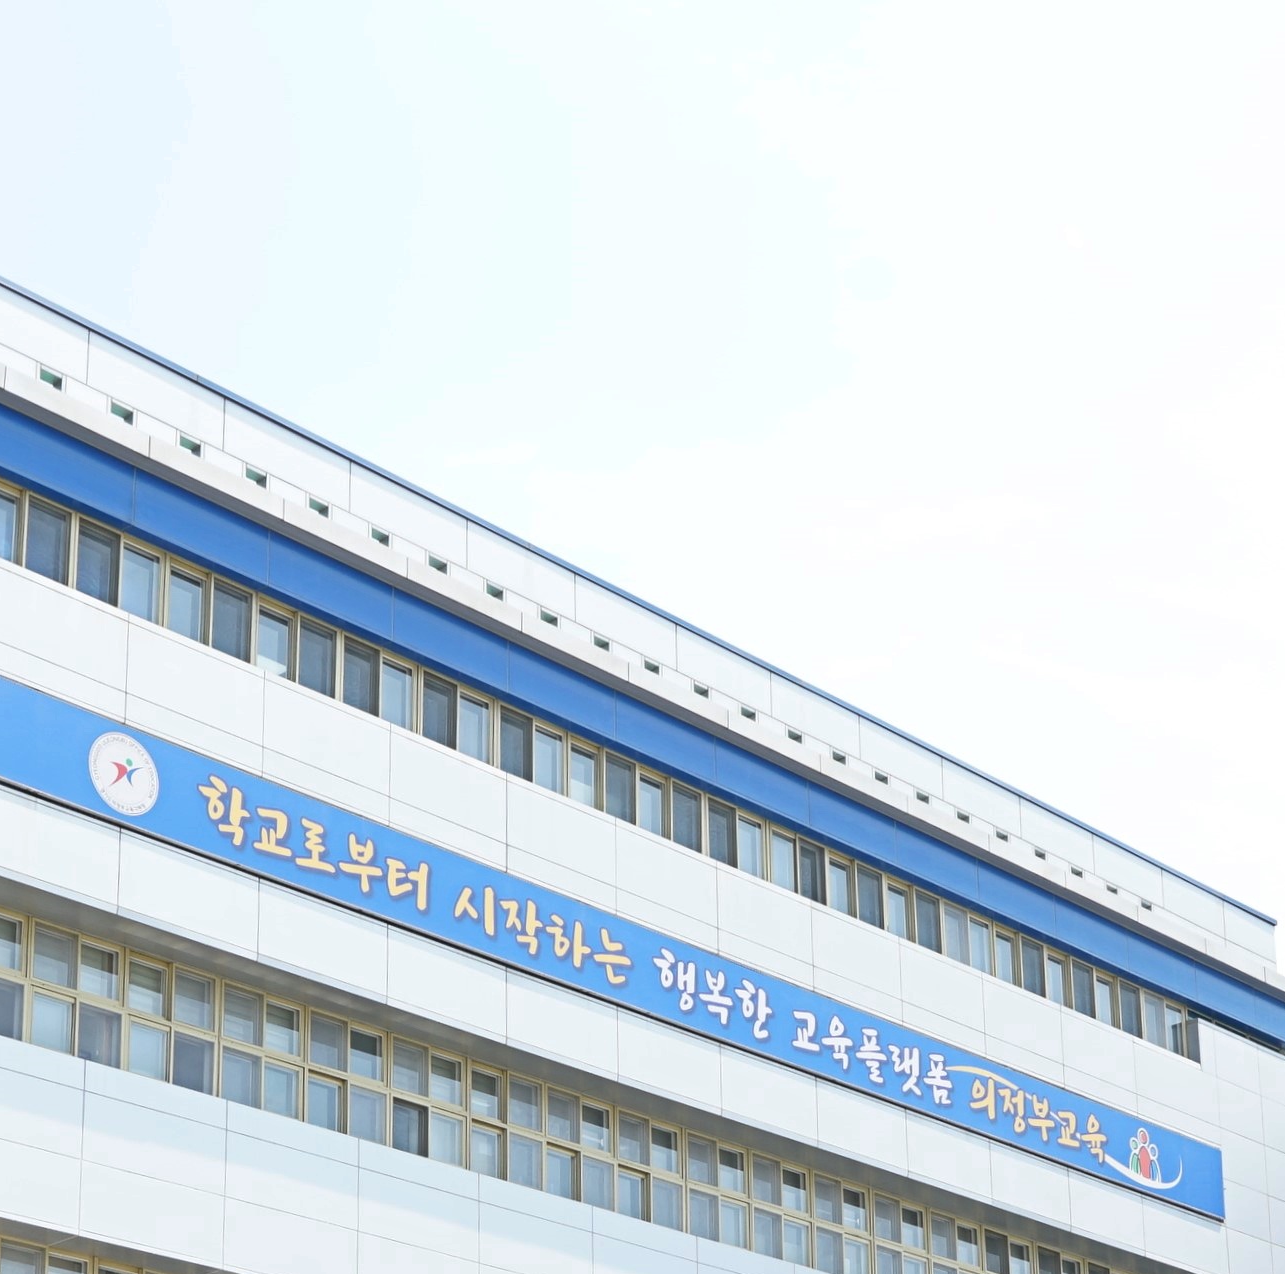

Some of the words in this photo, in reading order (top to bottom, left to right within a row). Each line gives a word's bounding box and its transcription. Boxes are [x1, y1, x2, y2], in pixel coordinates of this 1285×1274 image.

[197, 775, 430, 911] 학교로부터
[453, 886, 633, 985] 시작하는
[653, 947, 772, 1038] 행복한
[792, 1009, 953, 1106] 교육플랫폼
[969, 1078, 1108, 1162] 의정부교육
